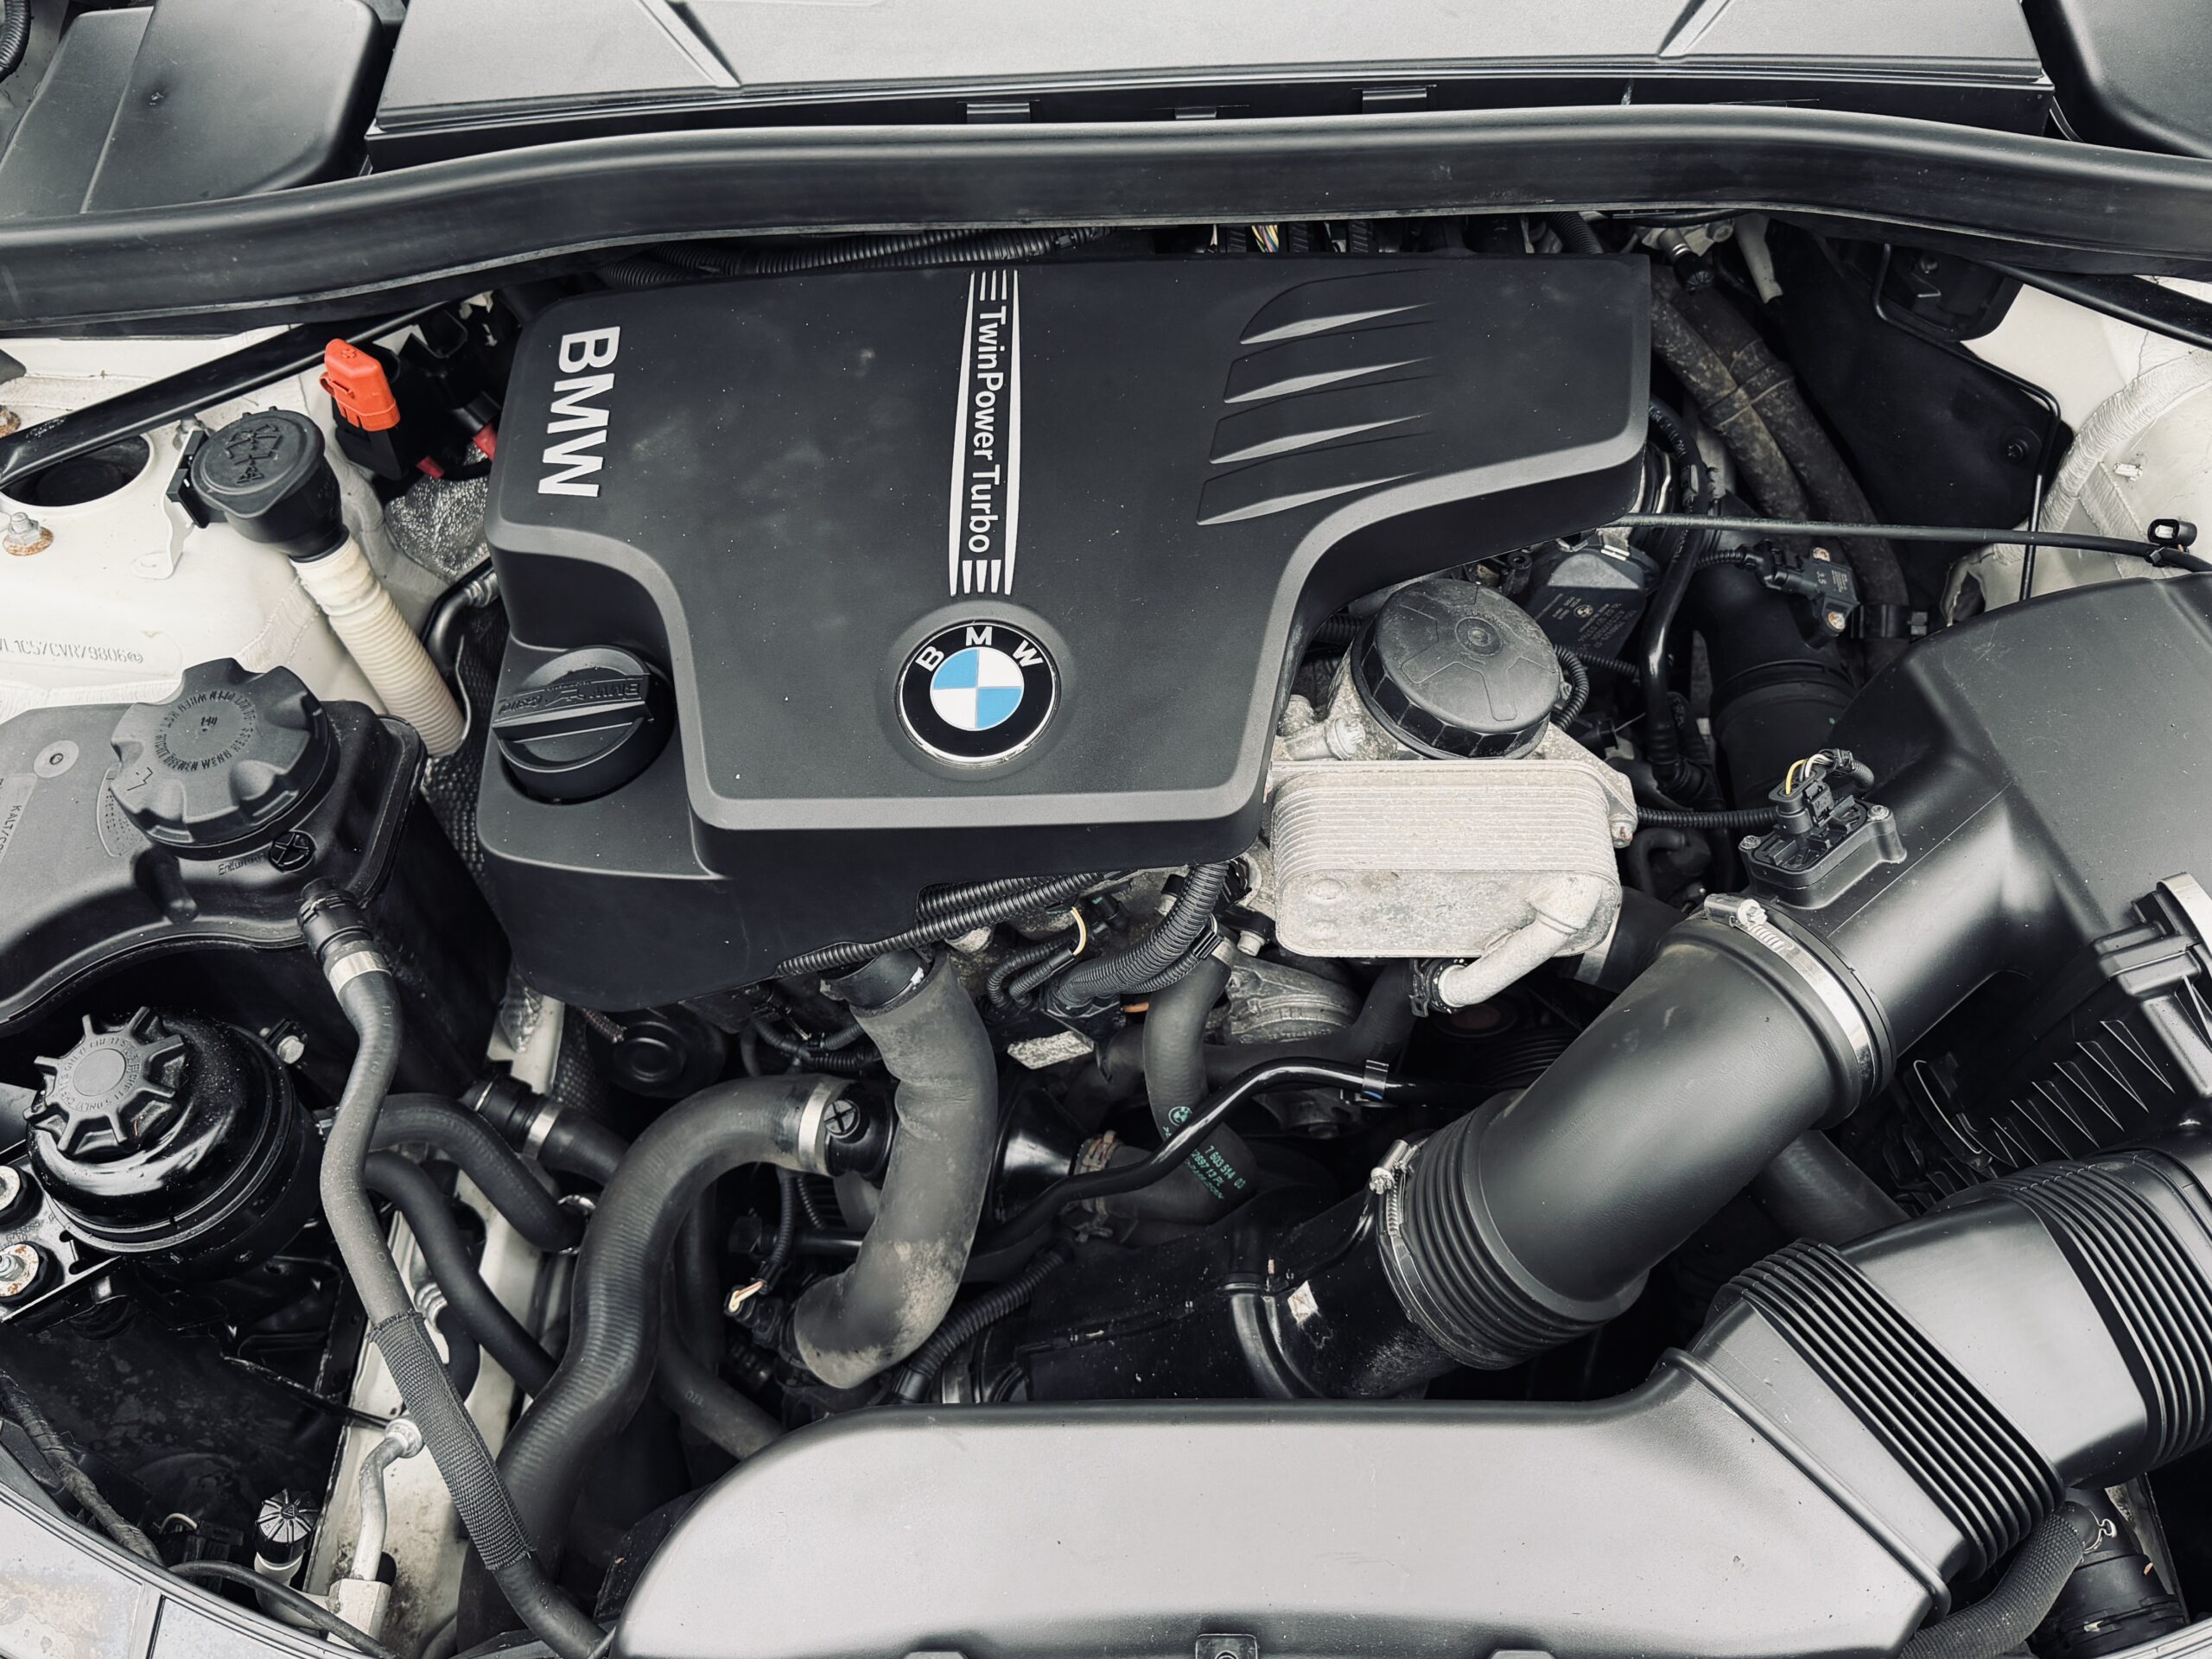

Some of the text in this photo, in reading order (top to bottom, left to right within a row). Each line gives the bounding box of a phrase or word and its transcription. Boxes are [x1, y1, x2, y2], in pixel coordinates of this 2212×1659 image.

[537, 326, 620, 498] BMW
[968, 305, 1007, 553] TwinPower Turbo
[915, 626, 1044, 671] BMW
[1209, 1151, 1224, 1168] 603
[1219, 1164, 1236, 1180] 514
